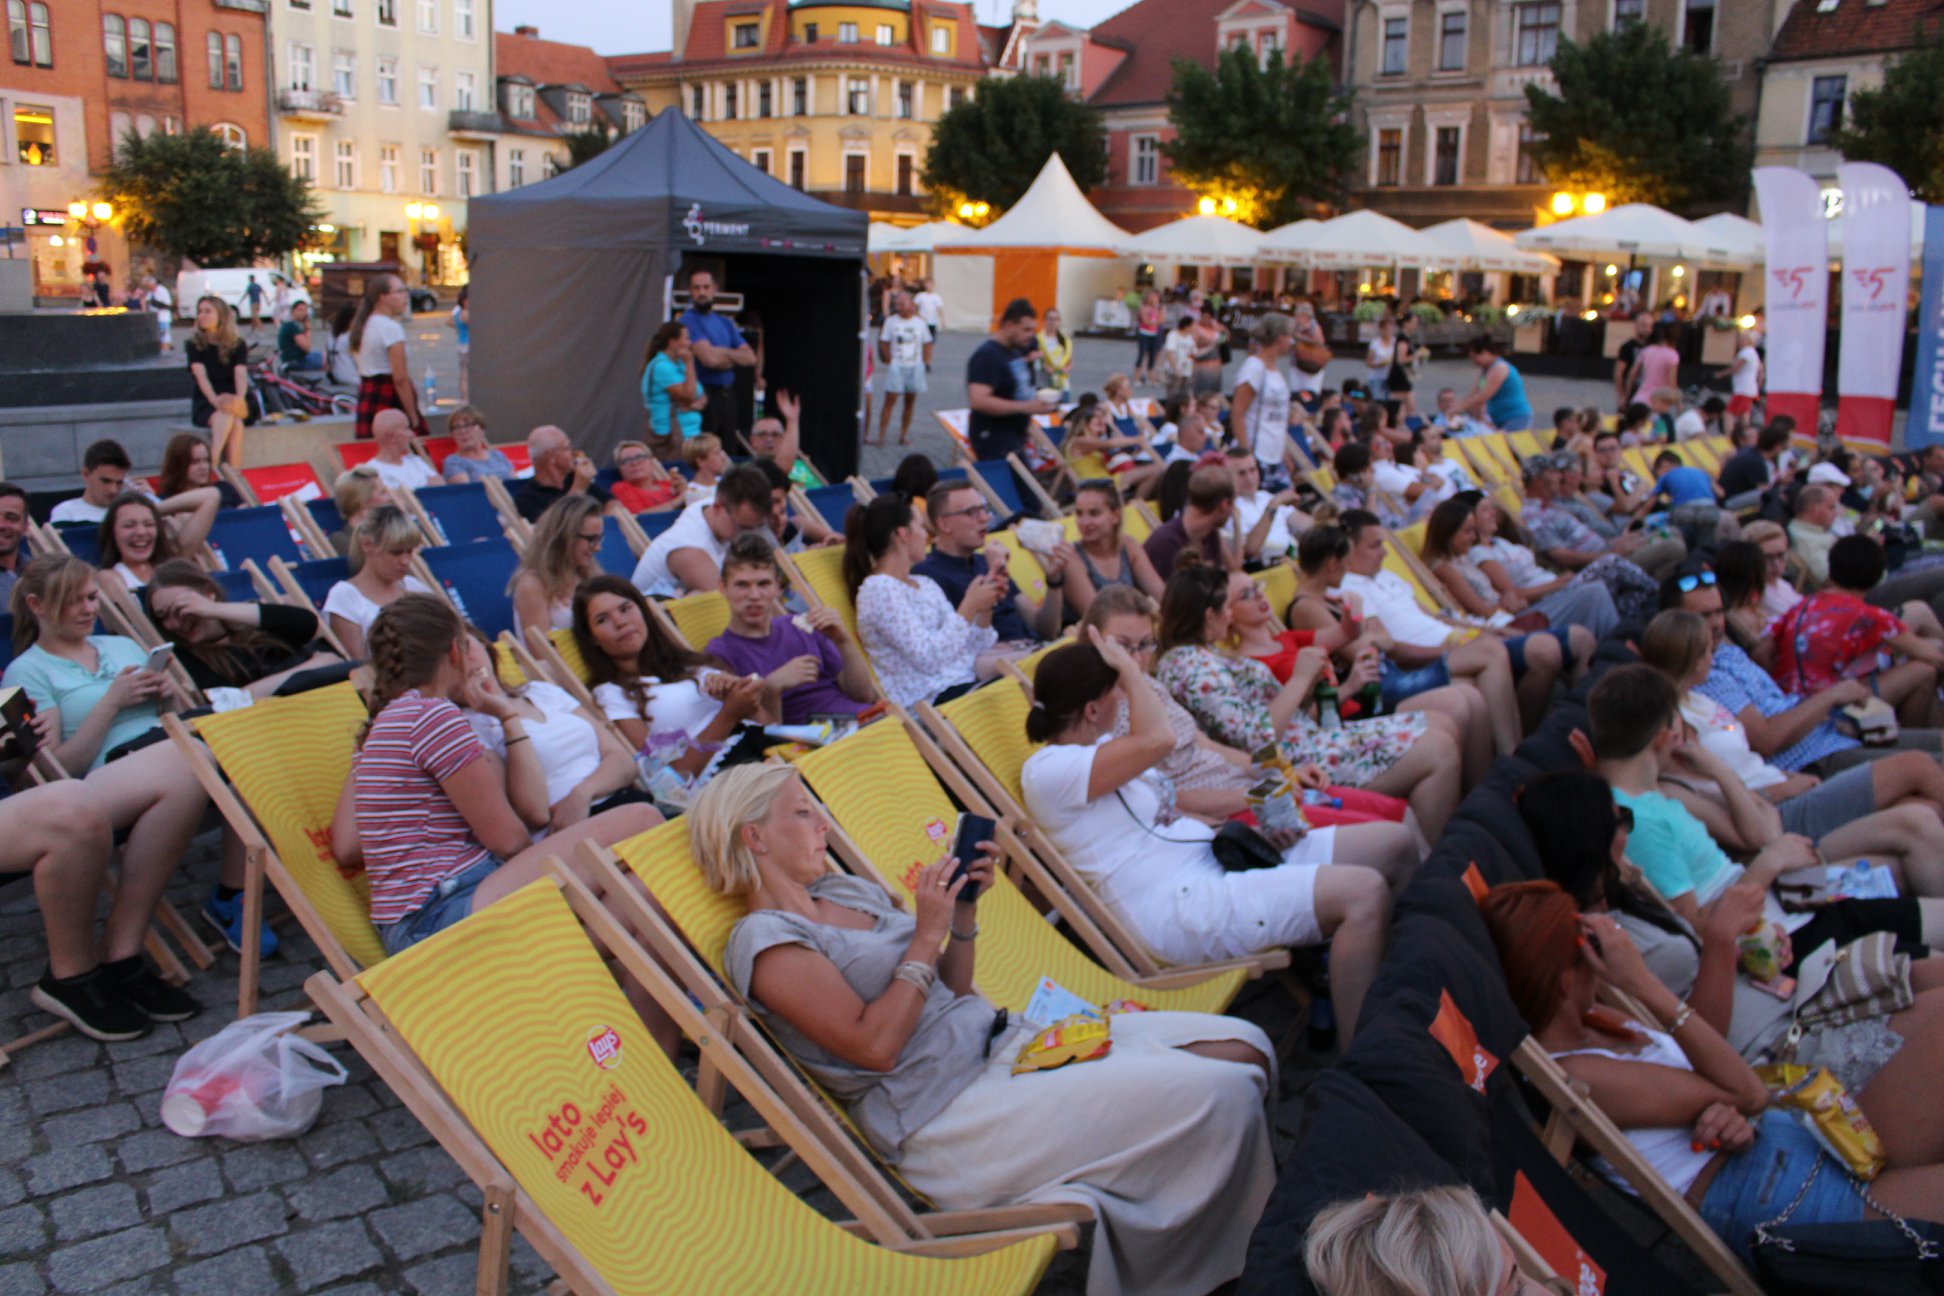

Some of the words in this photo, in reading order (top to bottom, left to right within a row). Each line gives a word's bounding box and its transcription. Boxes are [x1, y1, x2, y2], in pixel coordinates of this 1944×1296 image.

[528, 1102, 582, 1161] lato
[556, 1125, 597, 1183] smakuje
[590, 1083, 627, 1129] lepiej
[586, 1111, 647, 1188] Lay's
[580, 1181, 603, 1207] z
